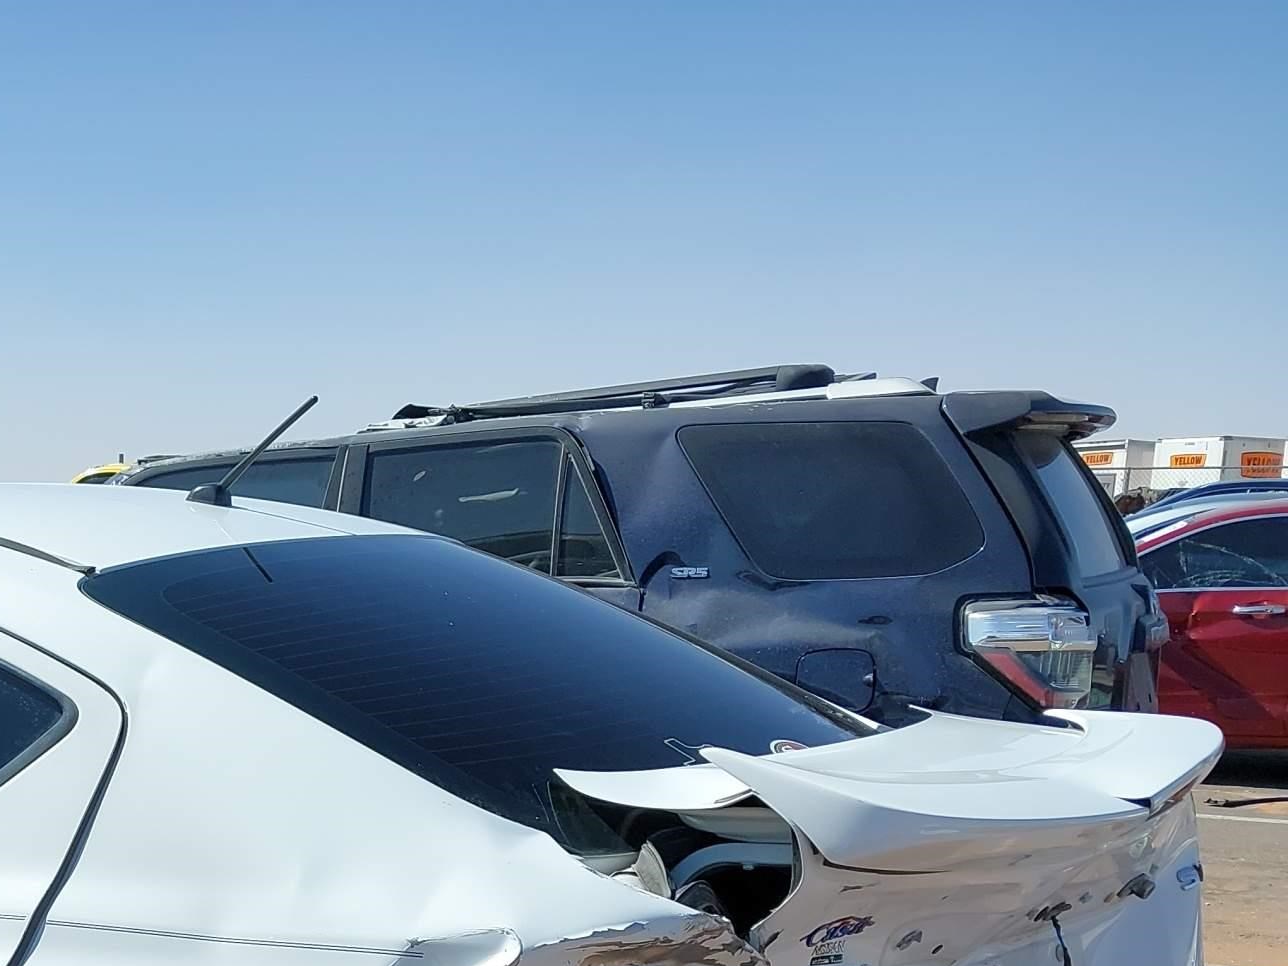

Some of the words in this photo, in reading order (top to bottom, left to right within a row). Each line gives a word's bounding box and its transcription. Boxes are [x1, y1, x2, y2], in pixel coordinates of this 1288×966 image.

[1086, 454, 1110, 464] YELLOW
[1174, 455, 1203, 466] YELLOW
[671, 566, 709, 578] SR5
